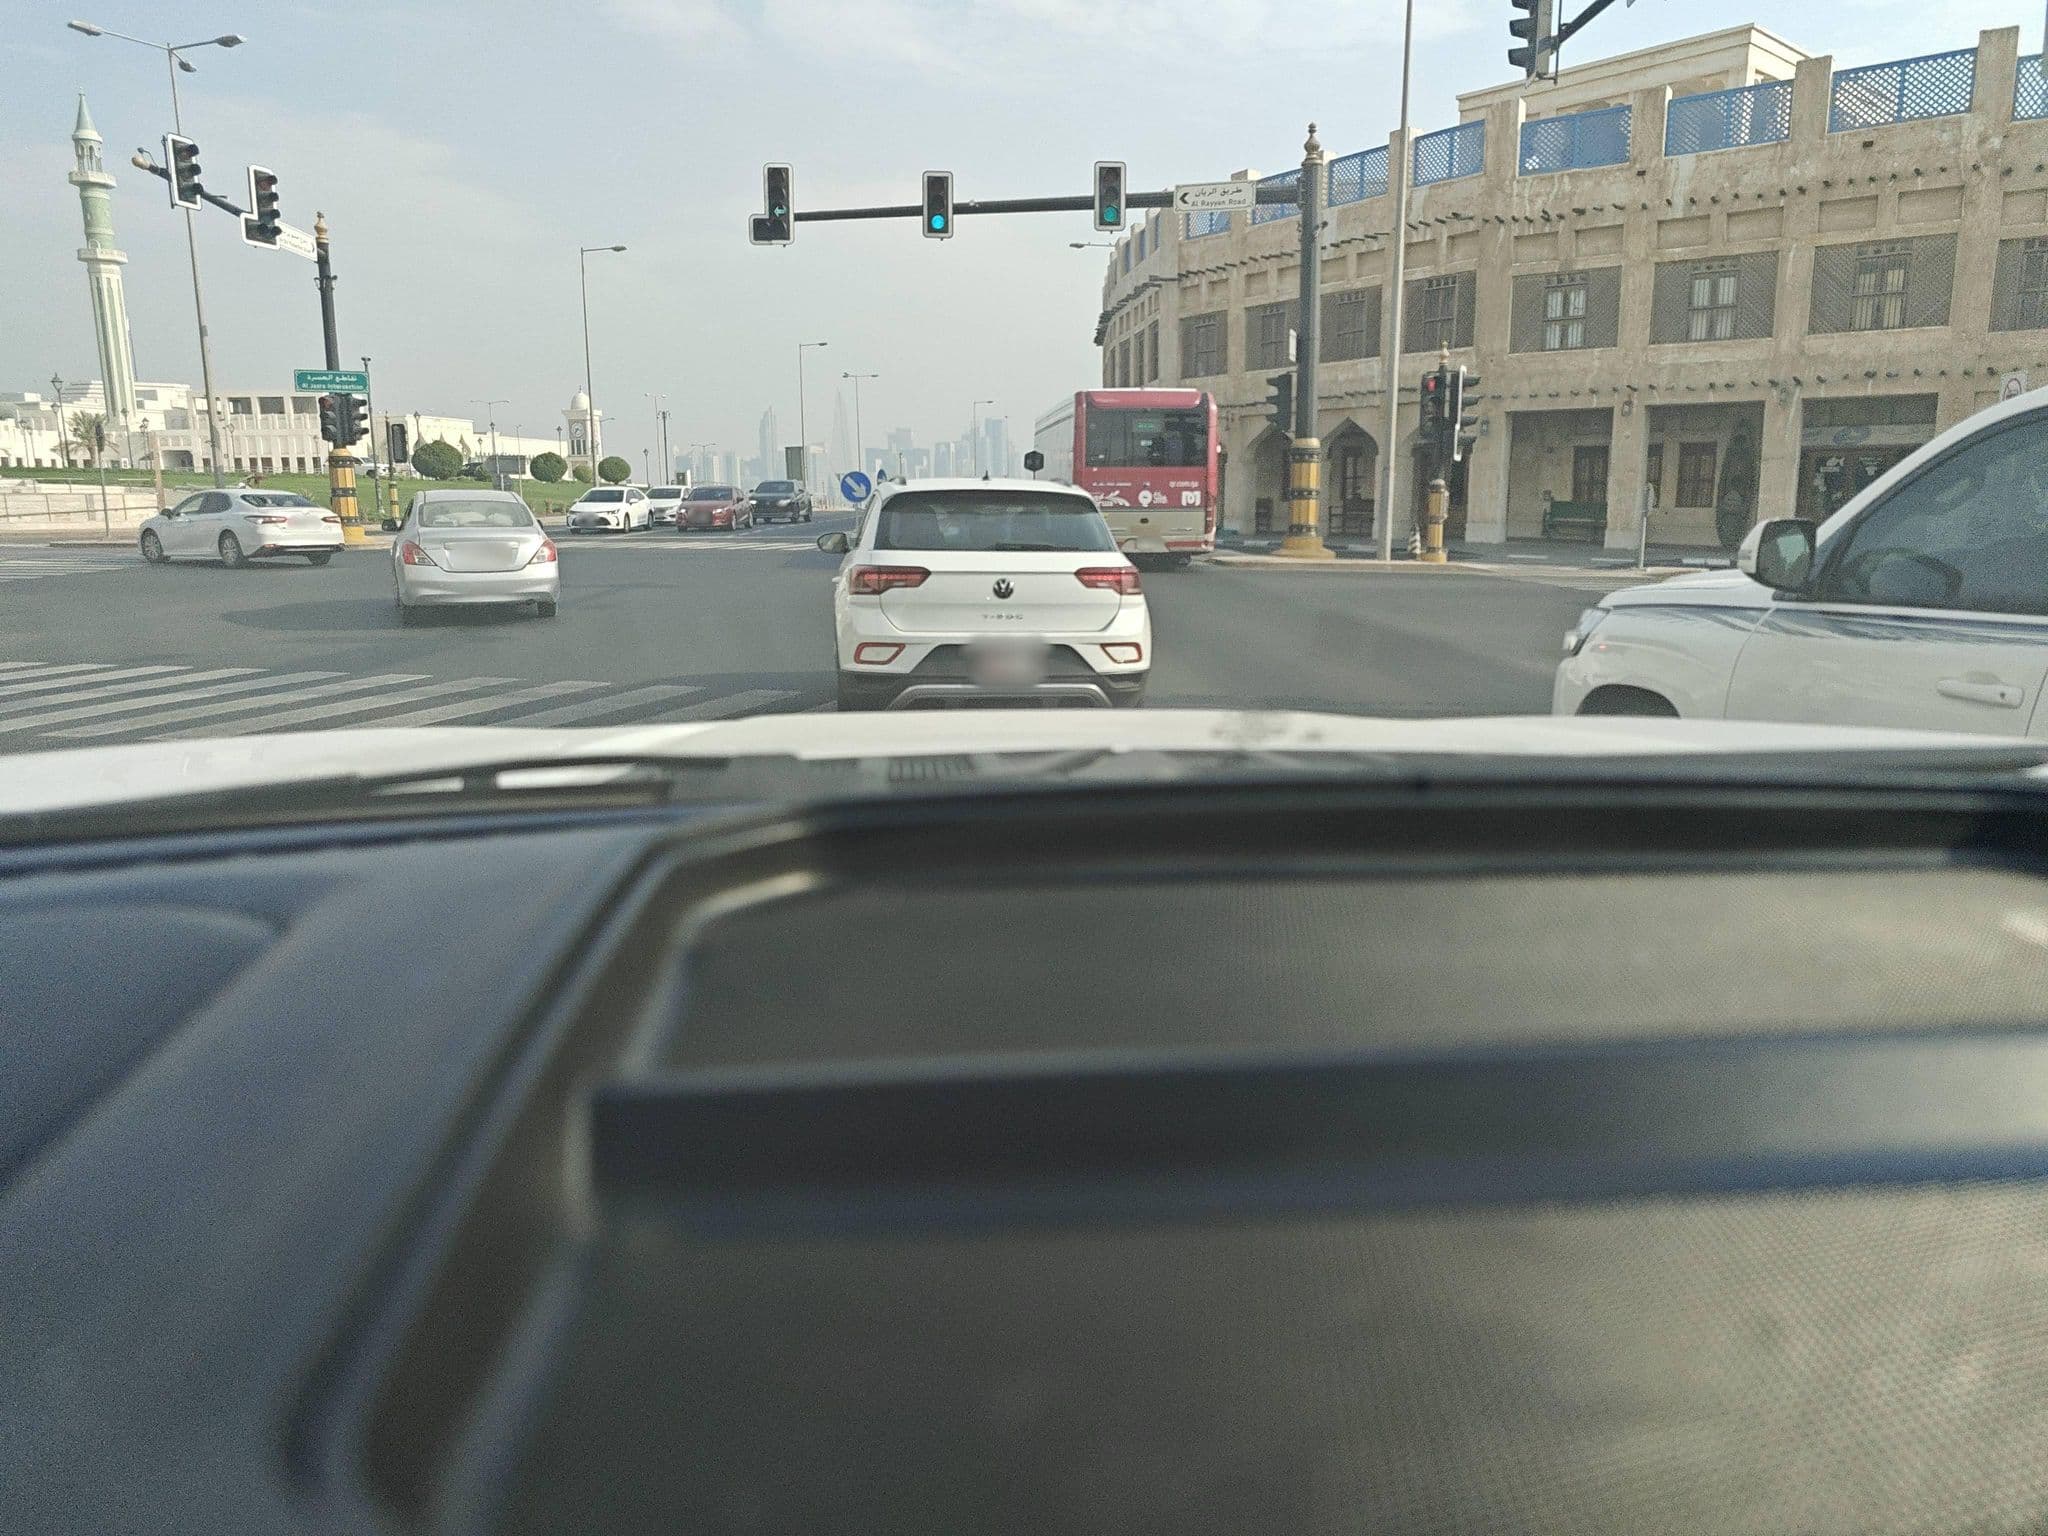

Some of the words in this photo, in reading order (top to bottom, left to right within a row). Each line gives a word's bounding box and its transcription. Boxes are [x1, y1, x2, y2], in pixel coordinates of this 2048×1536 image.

[1194, 187, 1217, 198] الريان
[1219, 185, 1243, 197] طريق
[1200, 199, 1226, 208] Rayyan
[1228, 198, 1247, 206] Road
